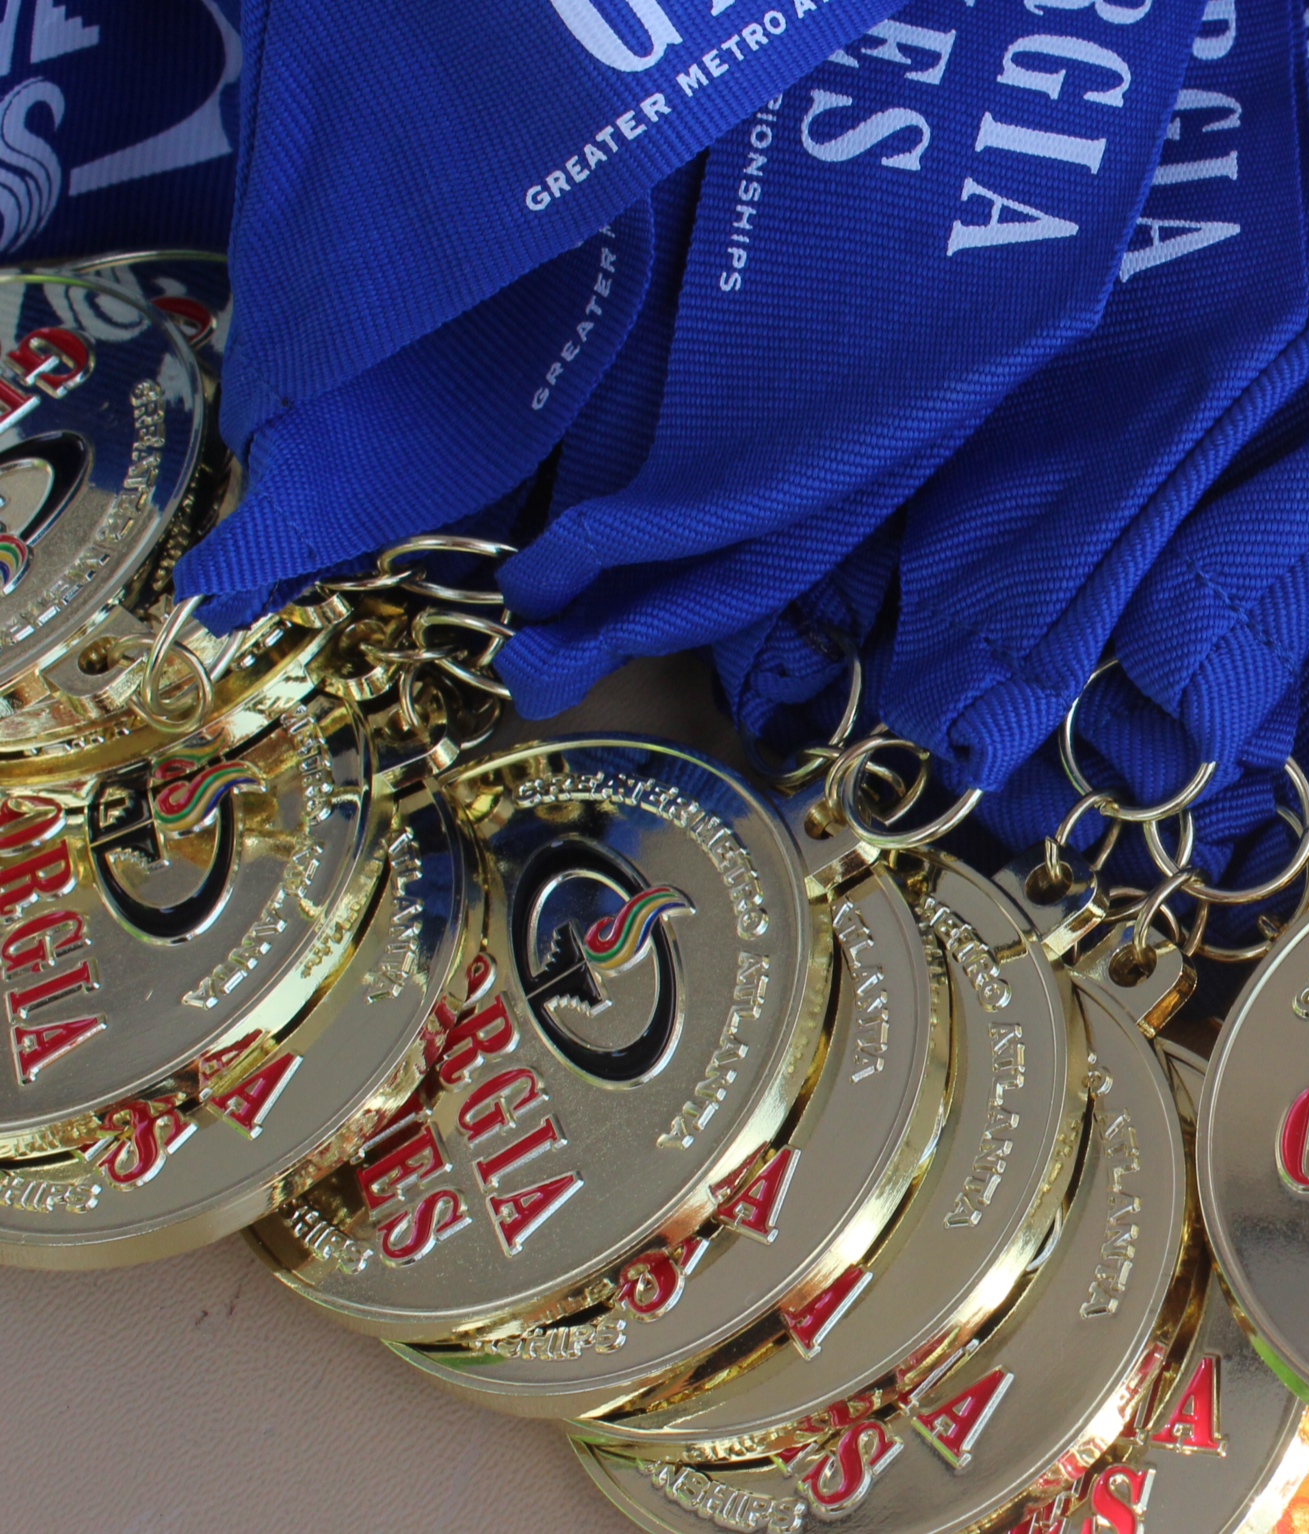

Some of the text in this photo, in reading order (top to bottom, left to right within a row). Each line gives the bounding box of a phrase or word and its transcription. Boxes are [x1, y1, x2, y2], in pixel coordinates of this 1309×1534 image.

[526, 92, 672, 212] GREATER
[676, 9, 788, 97] METRO
[530, 245, 618, 411] GREATER
[181, 837, 323, 1009] ATLANTA
[367, 825, 423, 1004] ATLANTA
[690, 811, 770, 940] METRO
[656, 951, 771, 1151] ATLANTA
[832, 899, 889, 1085] ATLANTA
[943, 1021, 1026, 1230] ATLANTA
[1079, 1107, 1141, 1320] ATLANTA
